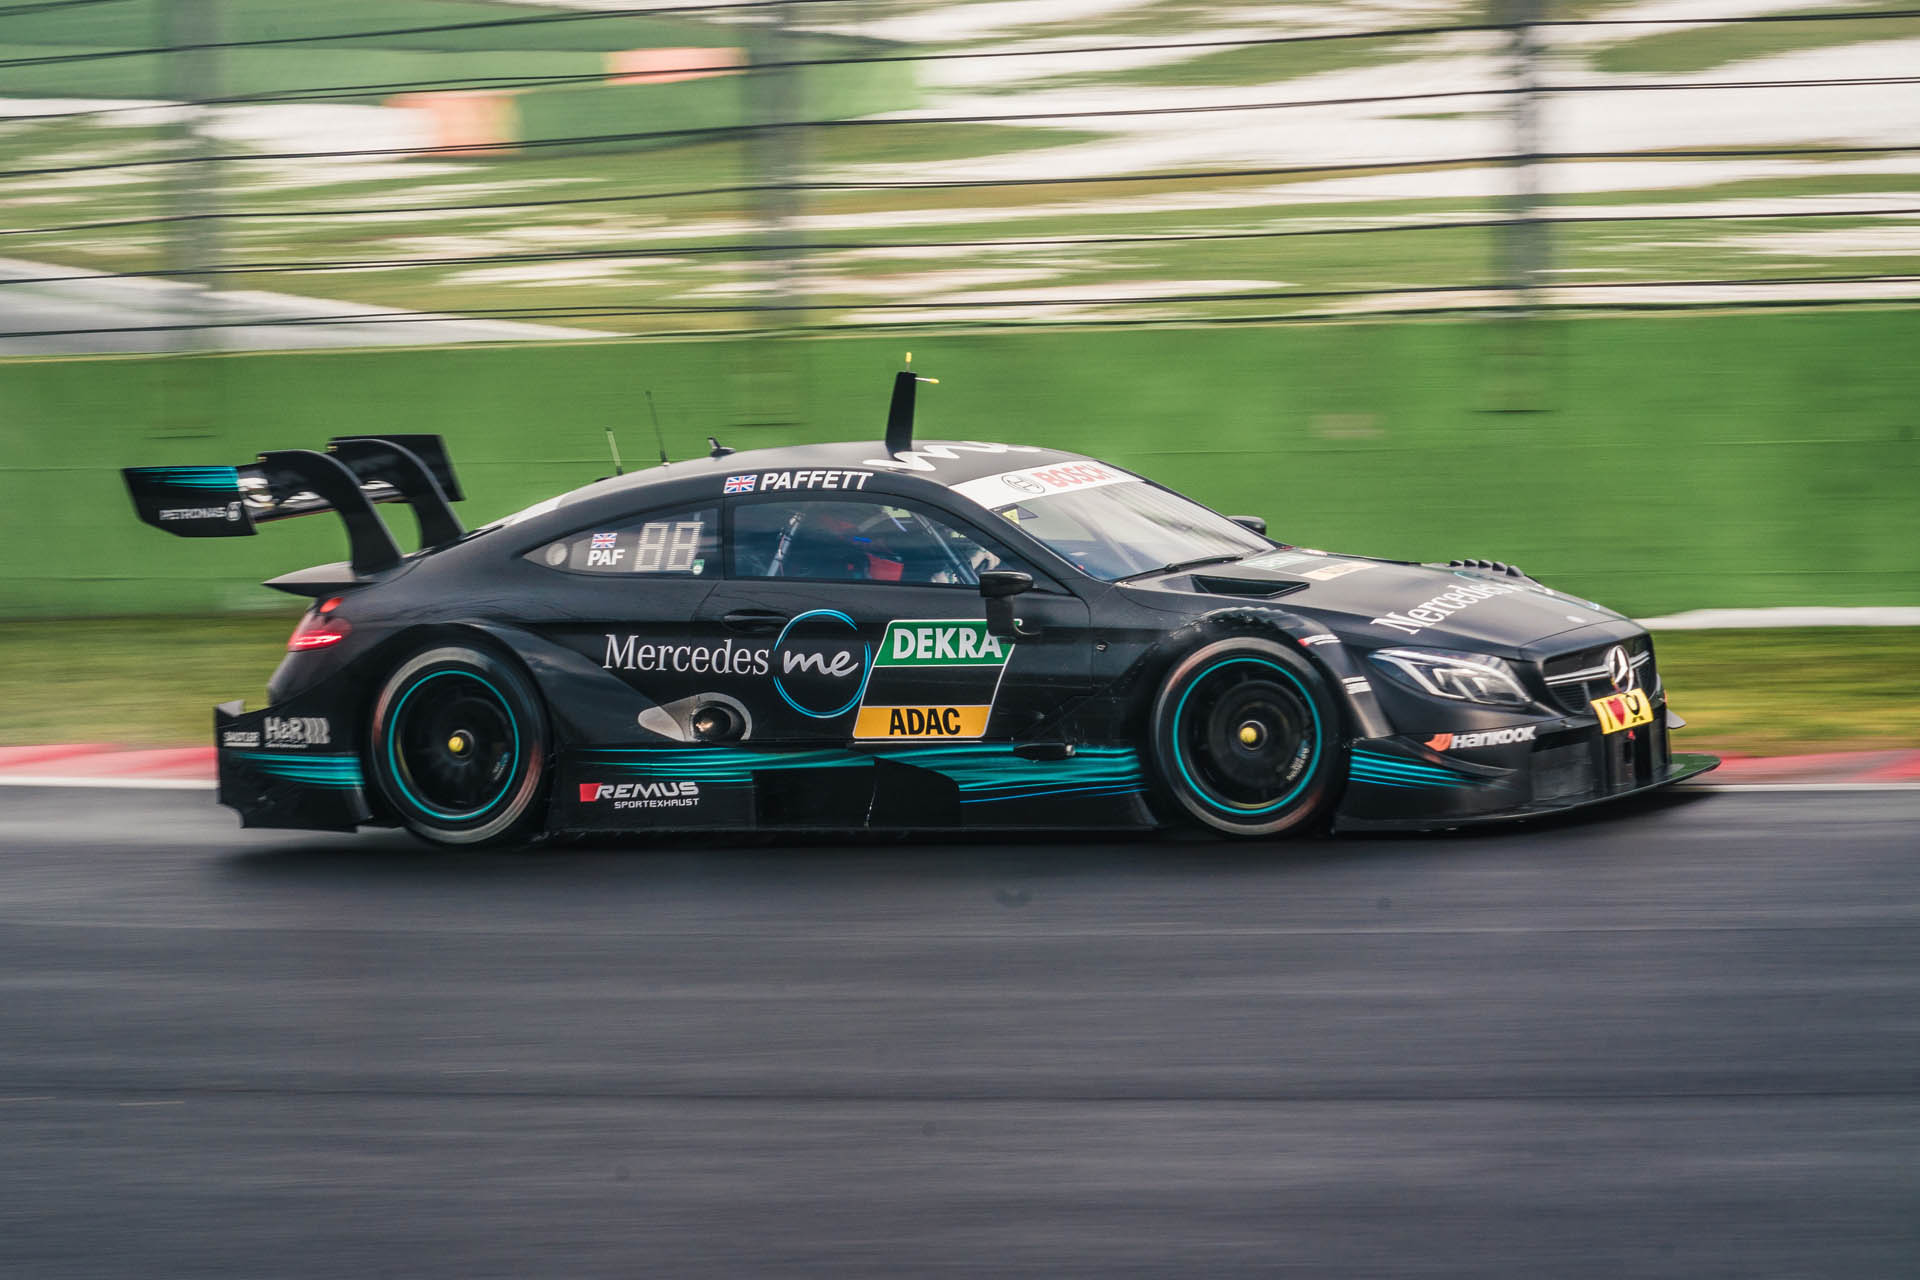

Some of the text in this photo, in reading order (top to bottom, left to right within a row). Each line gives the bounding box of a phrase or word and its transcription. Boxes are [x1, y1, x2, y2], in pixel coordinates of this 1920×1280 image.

[760, 471, 874, 491] PAFFETT
[1031, 464, 1119, 487] BOSCH
[587, 549, 626, 566] PAF
[892, 625, 1003, 661] DEKRA
[602, 634, 859, 678] Mercedes me
[889, 707, 961, 736] ADAC
[594, 782, 700, 800] REMUS
[614, 798, 700, 809] SPORTEXHAUST
